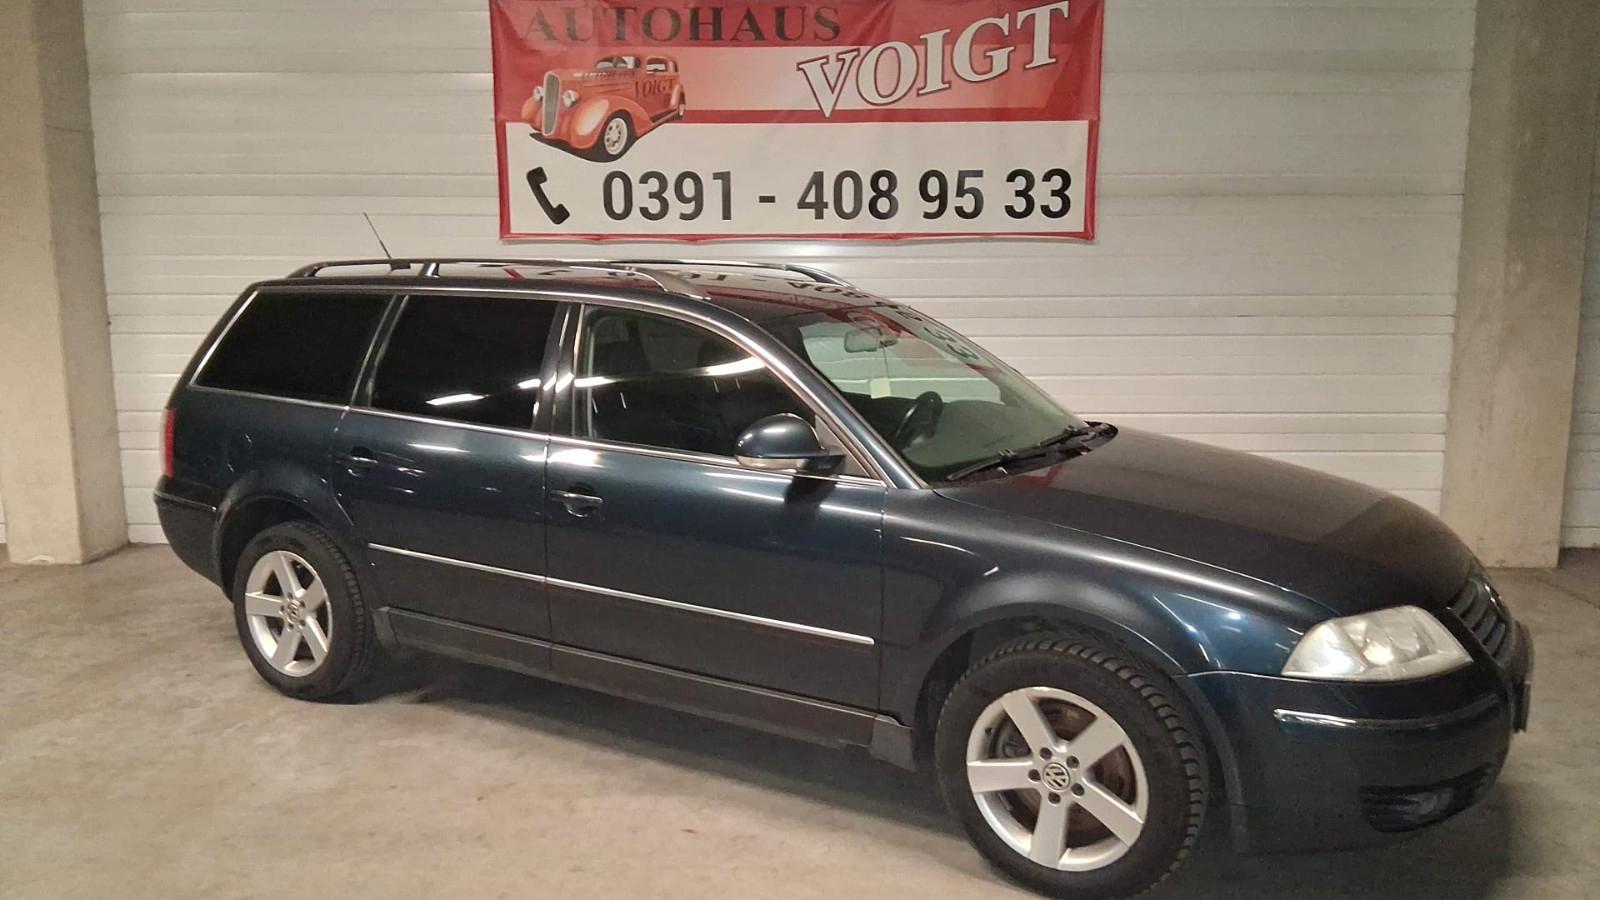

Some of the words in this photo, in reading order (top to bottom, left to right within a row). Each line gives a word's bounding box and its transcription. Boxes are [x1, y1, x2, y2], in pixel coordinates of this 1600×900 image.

[526, 5, 841, 42] AUTOHAUS
[796, 0, 1071, 118] VOIGT
[603, 170, 732, 221] 0391
[797, 169, 899, 220] 408
[918, 169, 985, 220] 95
[1004, 168, 1072, 219] 33
